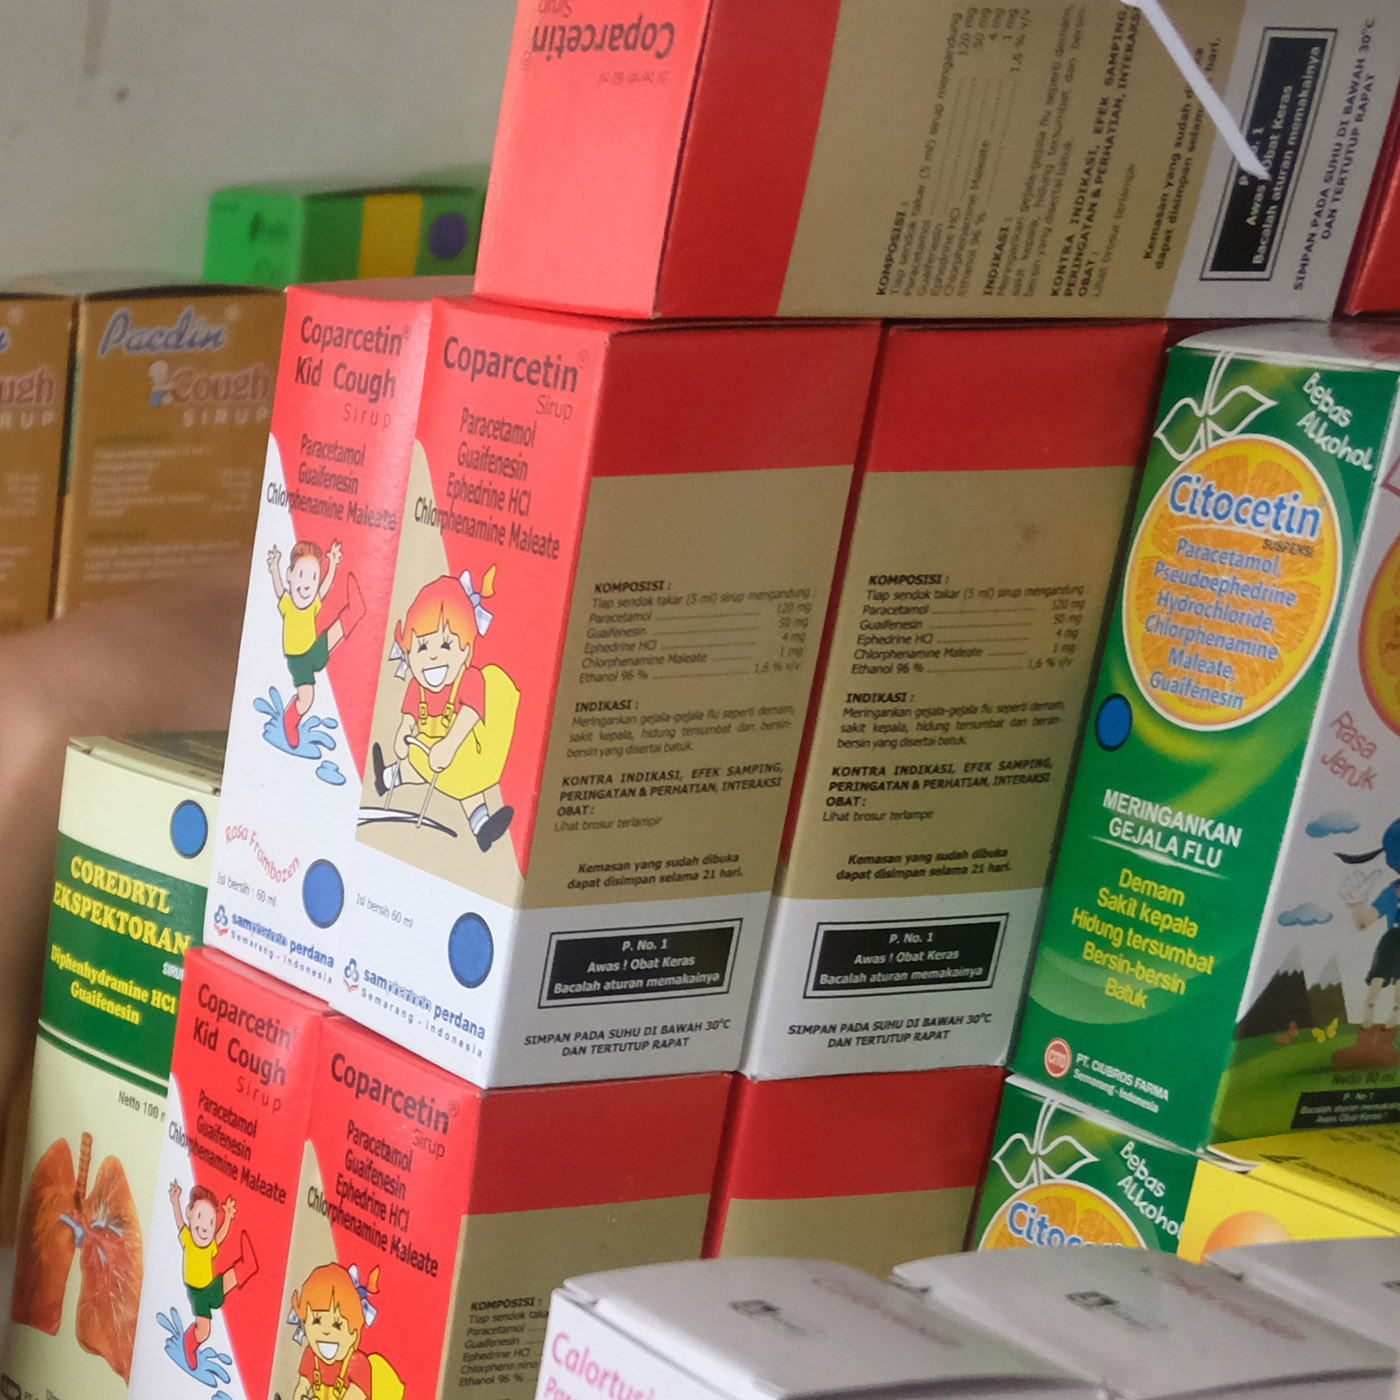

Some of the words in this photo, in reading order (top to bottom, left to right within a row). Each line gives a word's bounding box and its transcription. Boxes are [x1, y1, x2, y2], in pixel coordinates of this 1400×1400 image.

[532, 14, 675, 61] Coparcetin
[100, 307, 226, 360] Pacdin
[301, 316, 402, 355] Coparcetin
[174, 362, 271, 406] Cough
[295, 356, 323, 387] Kid
[333, 363, 397, 403] Cough
[443, 336, 579, 394] Coparcetin
[342, 403, 392, 430] Sirup
[535, 394, 574, 421] Sirup
[1302, 371, 1353, 428] Bebas
[300, 433, 365, 466] Paracetamol
[460, 407, 538, 448] Paracetamol
[1297, 411, 1375, 471] Alkohol
[298, 463, 359, 495] Guaifenesin
[457, 441, 528, 481] Guaifenesin
[266, 481, 345, 523] Chlorphenamine
[346, 500, 398, 532] Maleate
[446, 472, 505, 512] Ephedrine
[508, 487, 532, 517] HCl
[1168, 473, 1321, 538] Citocetin
[414, 496, 506, 546] Chlorphenamine
[508, 525, 561, 561] Maleate
[1177, 536, 1281, 578] Paracetamol,
[594, 580, 666, 594] KOMPOSISI
[1154, 561, 1297, 607] Pseudoephedrine
[1157, 590, 1276, 634] Hydrochloride,
[1144, 614, 1279, 662] Chlorphenamine
[1167, 646, 1236, 681] Maleate,
[575, 699, 633, 713] INDIKASI
[1149, 670, 1245, 711] Guaifenesin
[1329, 711, 1379, 760] Rasa
[561, 774, 614, 788] KONTRA
[1320, 748, 1379, 791] Jeruk
[1102, 788, 1243, 849] MERINGANKAN
[225, 823, 248, 845] Rasa
[249, 830, 300, 884] Frambozen
[1108, 817, 1180, 859] GEJALA
[1181, 841, 1223, 870] FLU
[70, 854, 171, 915] COREDRYL
[227, 875, 251, 895] bersih
[255, 885, 267, 902] 60
[268, 892, 277, 908] ml
[1118, 867, 1185, 907] Demam
[53, 880, 192, 958] EKSPEKTORAN
[356, 892, 365, 907] Isi
[365, 896, 390, 919] bersih
[390, 905, 403, 924] 60
[403, 913, 414, 929] ml
[1097, 887, 1138, 916] Sakit
[1138, 903, 1198, 940] kepala
[289, 938, 335, 970] perdana
[587, 961, 620, 973] Awas
[630, 958, 659, 970] Obat
[662, 955, 696, 968] Keras
[1070, 907, 1124, 948] Hidung
[1126, 927, 1216, 975] tersumbat
[51, 944, 150, 1003] Diphenhydramine
[151, 989, 178, 1015] HCl
[553, 981, 601, 995] Bacalah
[603, 978, 643, 991] aturan
[646, 972, 720, 988] memakainya
[1082, 941, 1186, 996] Bersin-bersin
[70, 981, 143, 1026] Guaifenesin
[1105, 977, 1148, 1010] Batuk
[198, 983, 292, 1051] Coparcetin
[360, 987, 415, 1026] Semarang
[425, 1021, 483, 1058] Indonesia
[433, 999, 486, 1041] perdana
[523, 1032, 571, 1046] SIMPAN
[573, 1029, 606, 1042] PADA
[608, 1026, 641, 1039] SUHU
[643, 1025, 658, 1036] DI
[660, 1022, 703, 1035] BAWAH
[193, 1016, 219, 1051] Kid
[227, 1037, 287, 1088] Cough
[561, 1044, 587, 1057] DAN
[590, 1040, 650, 1055] TERTUTUP
[652, 1036, 691, 1050] RAPAT
[118, 1090, 141, 1111] Netto
[143, 1101, 160, 1120] 100
[236, 1076, 282, 1112] Sirup
[330, 1053, 450, 1136] Coparcetin
[1134, 1077, 1169, 1102] FARMA
[198, 1089, 258, 1139] Paracetamol
[196, 1115, 252, 1162] Guaifenesin
[346, 1119, 413, 1174] Paracetamol
[411, 1128, 446, 1161] Sirup
[168, 1120, 238, 1181] Chlorphenamine
[239, 1162, 287, 1206] Maleate
[344, 1148, 407, 1202] Guaifenesin
[1120, 1140, 1166, 1197] Bebas
[335, 1172, 388, 1224] Ephedrine
[388, 1202, 410, 1234] HCl
[307, 1185, 388, 1252] Chlorphenamine
[389, 1232, 439, 1278] Maleate
